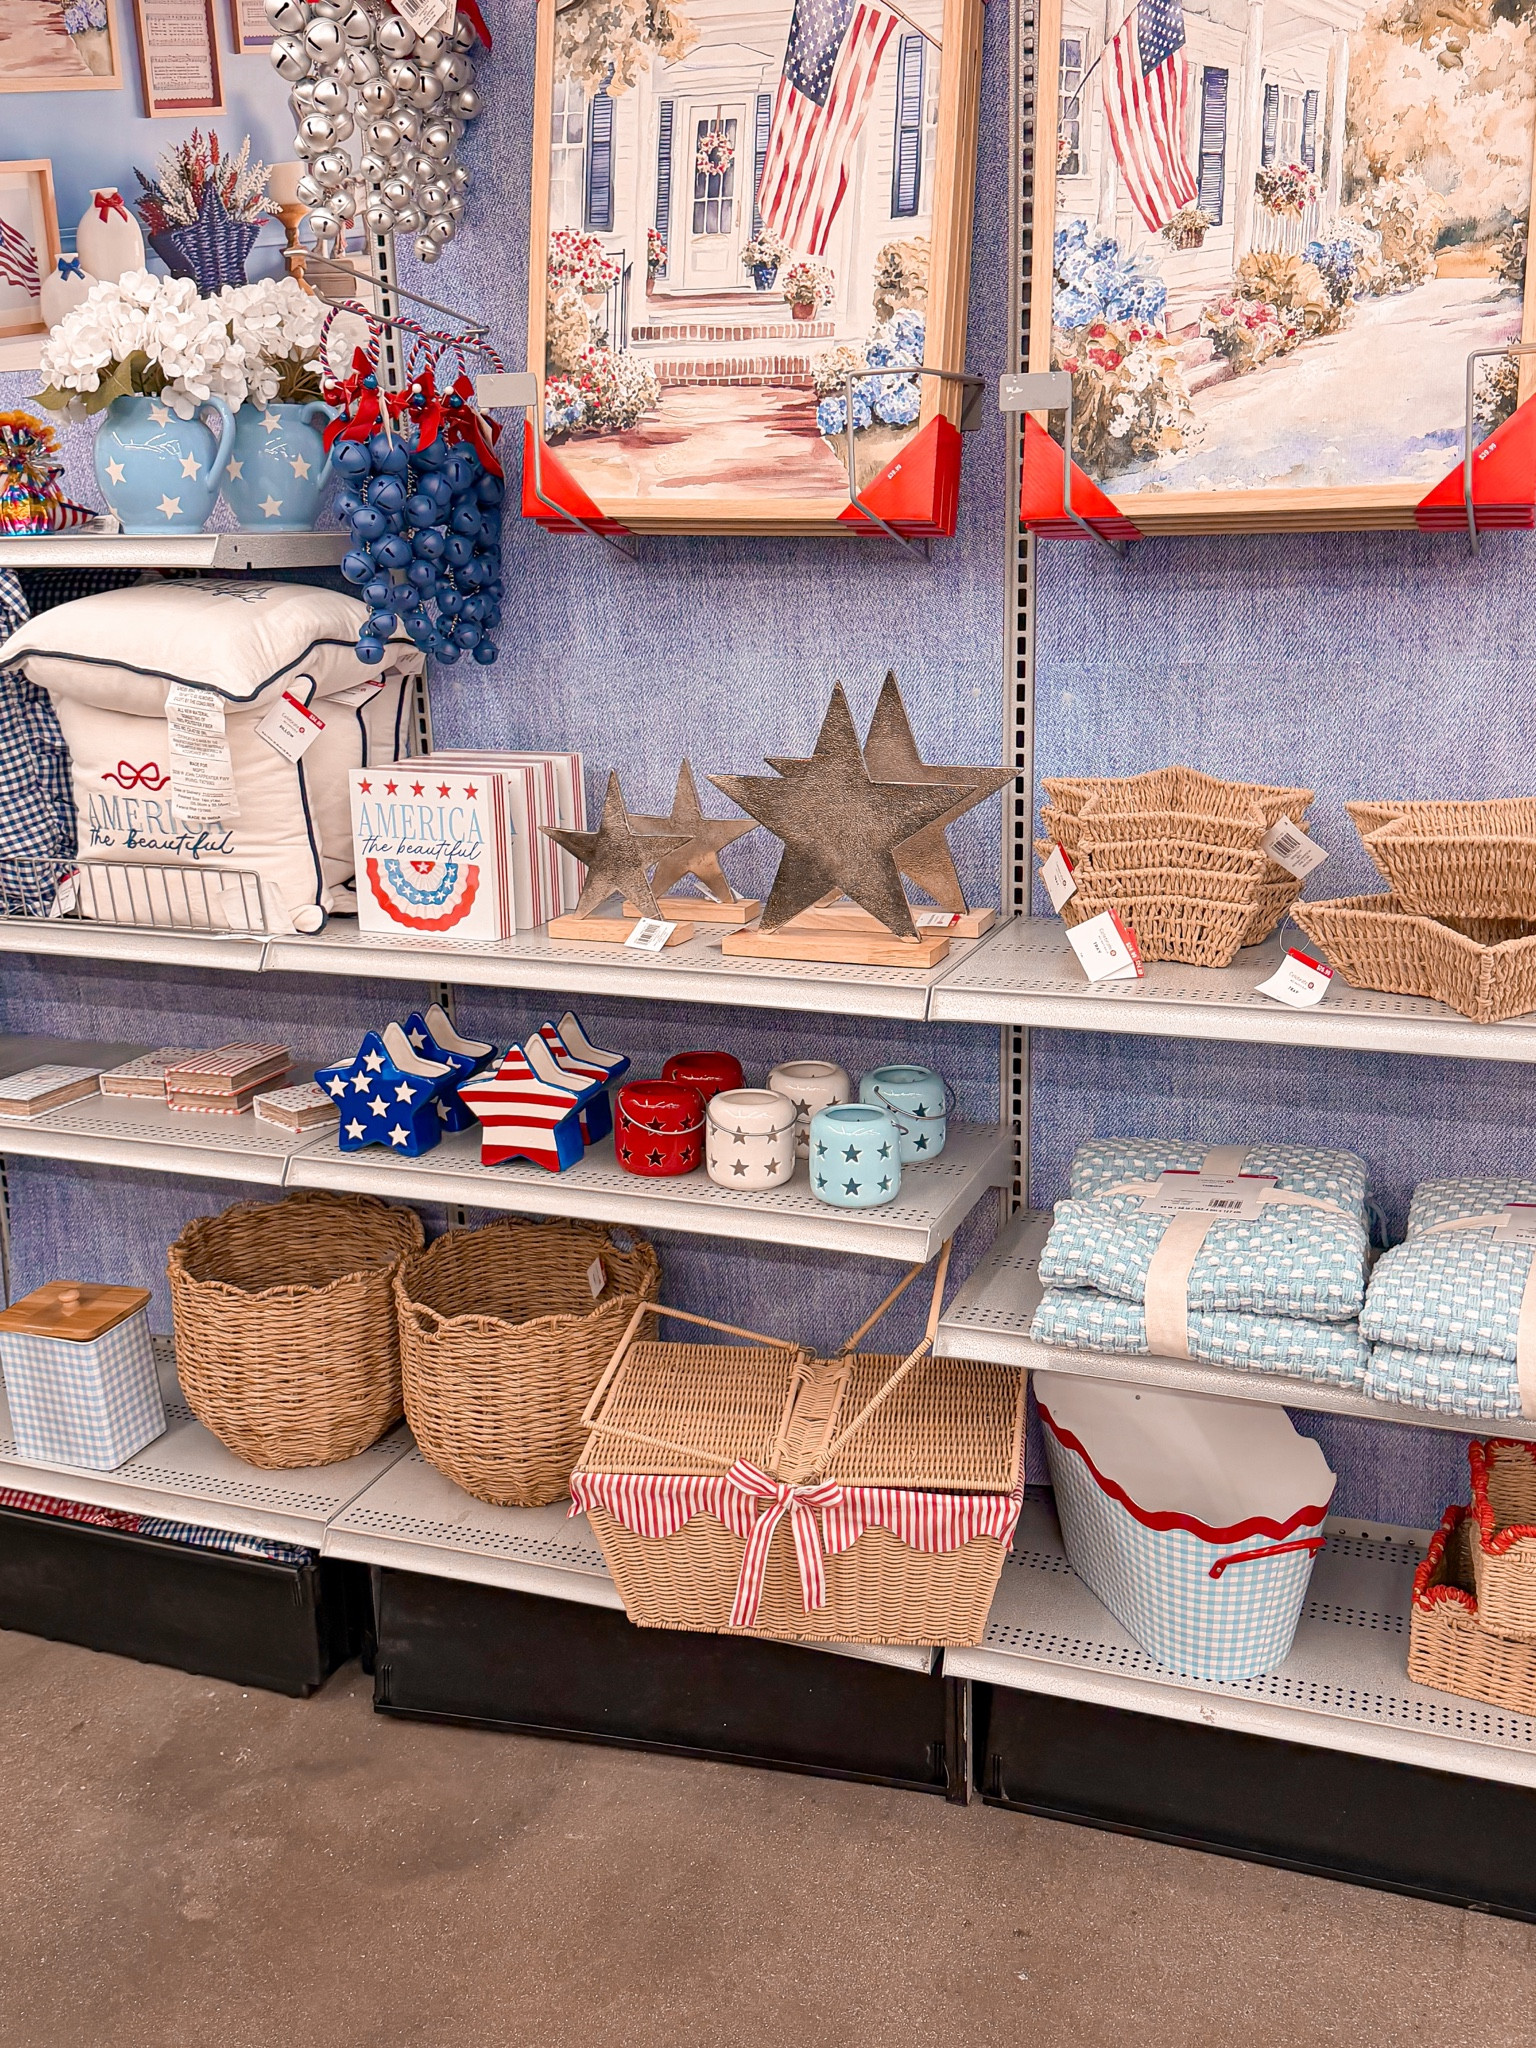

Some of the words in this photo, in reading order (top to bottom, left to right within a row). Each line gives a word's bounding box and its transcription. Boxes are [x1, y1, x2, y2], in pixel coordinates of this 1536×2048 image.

[358, 802, 485, 844] AMERICA
[89, 827, 115, 847] the
[123, 828, 235, 860] beautiful
[362, 835, 393, 855] the
[397, 837, 482, 864] beautiful
[1093, 941, 1102, 954] TRAY
